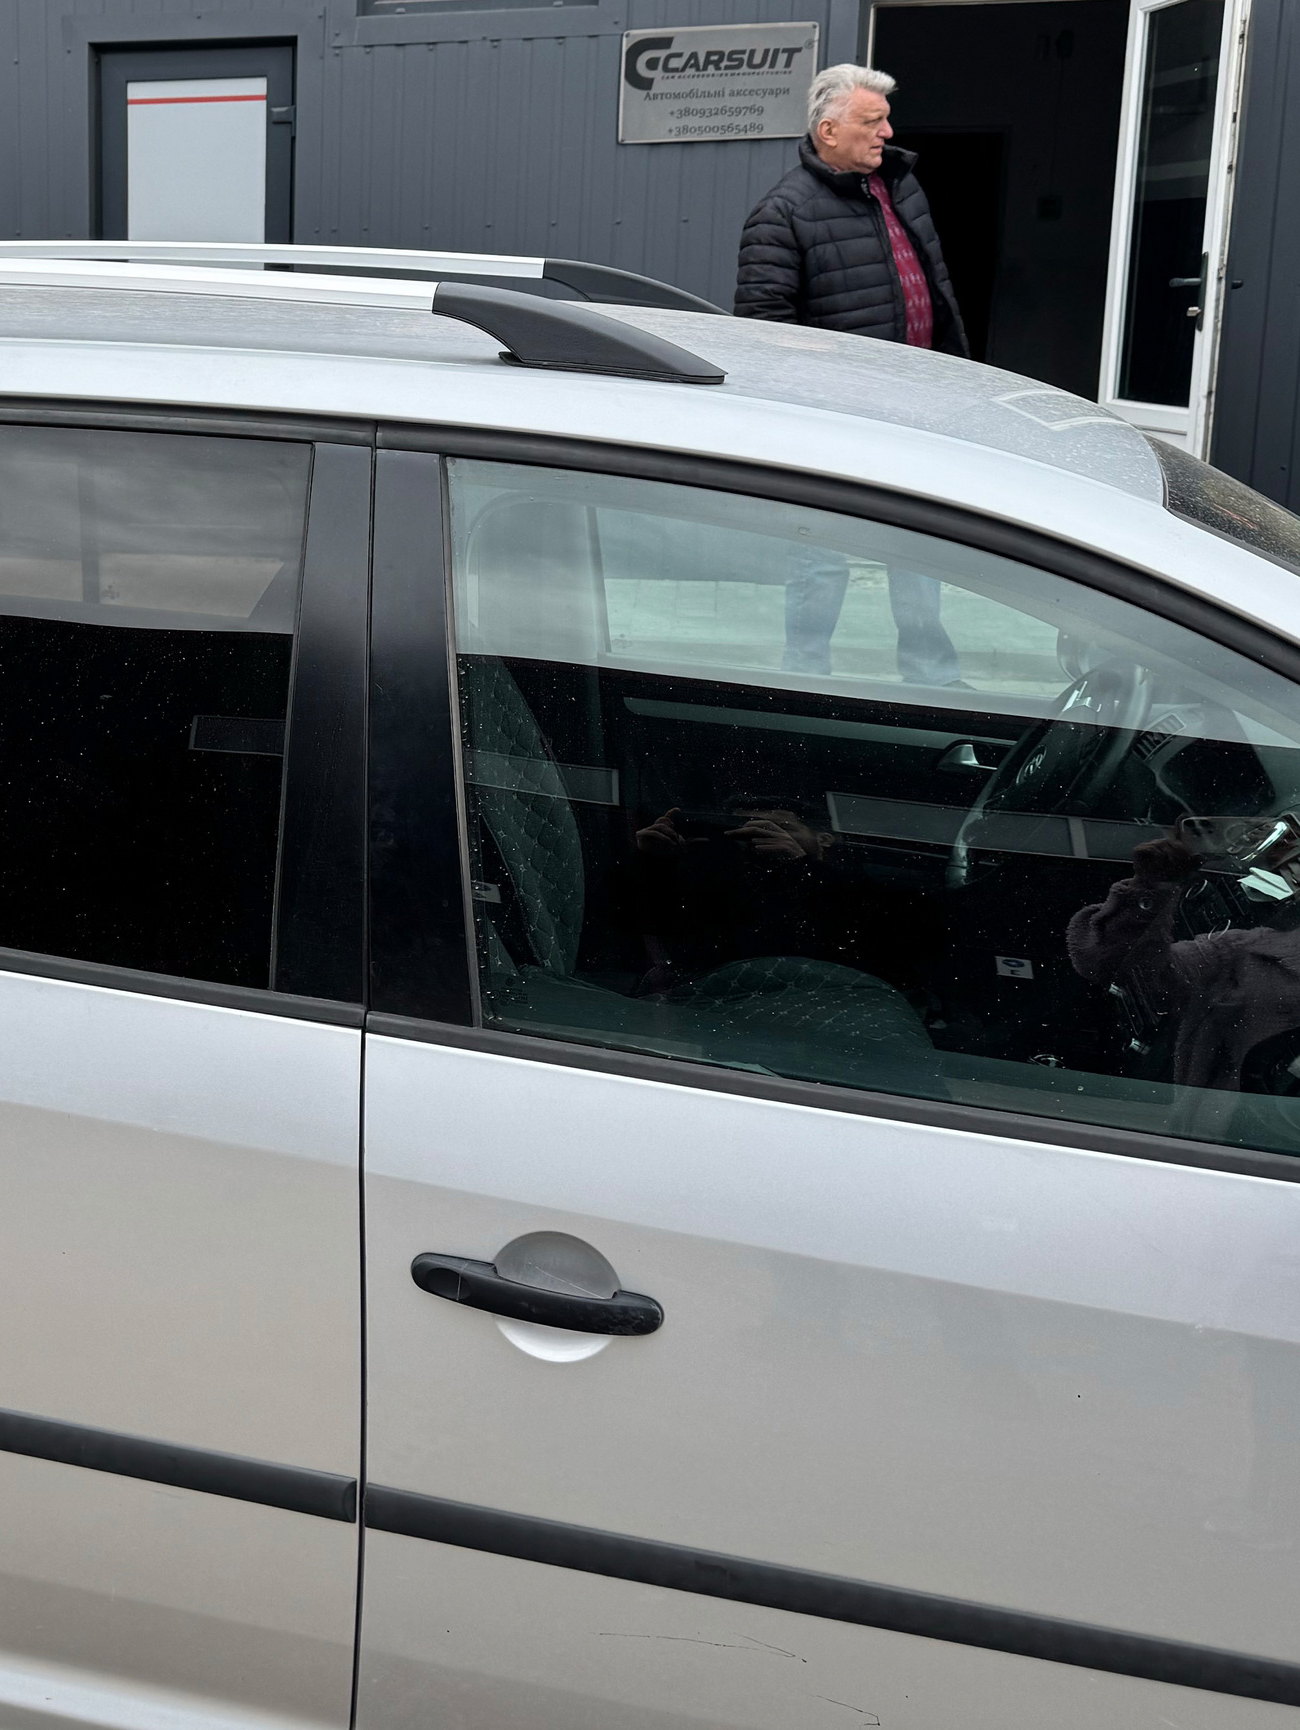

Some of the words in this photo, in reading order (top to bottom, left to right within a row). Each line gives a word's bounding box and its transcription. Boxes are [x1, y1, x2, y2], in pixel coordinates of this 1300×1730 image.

[661, 47, 803, 73] CARSUIT
[643, 87, 725, 101] Автомобільні
[729, 86, 791, 99] аксесуари
[668, 104, 764, 119] +380932659769
[667, 122, 764, 137] +380500565489
